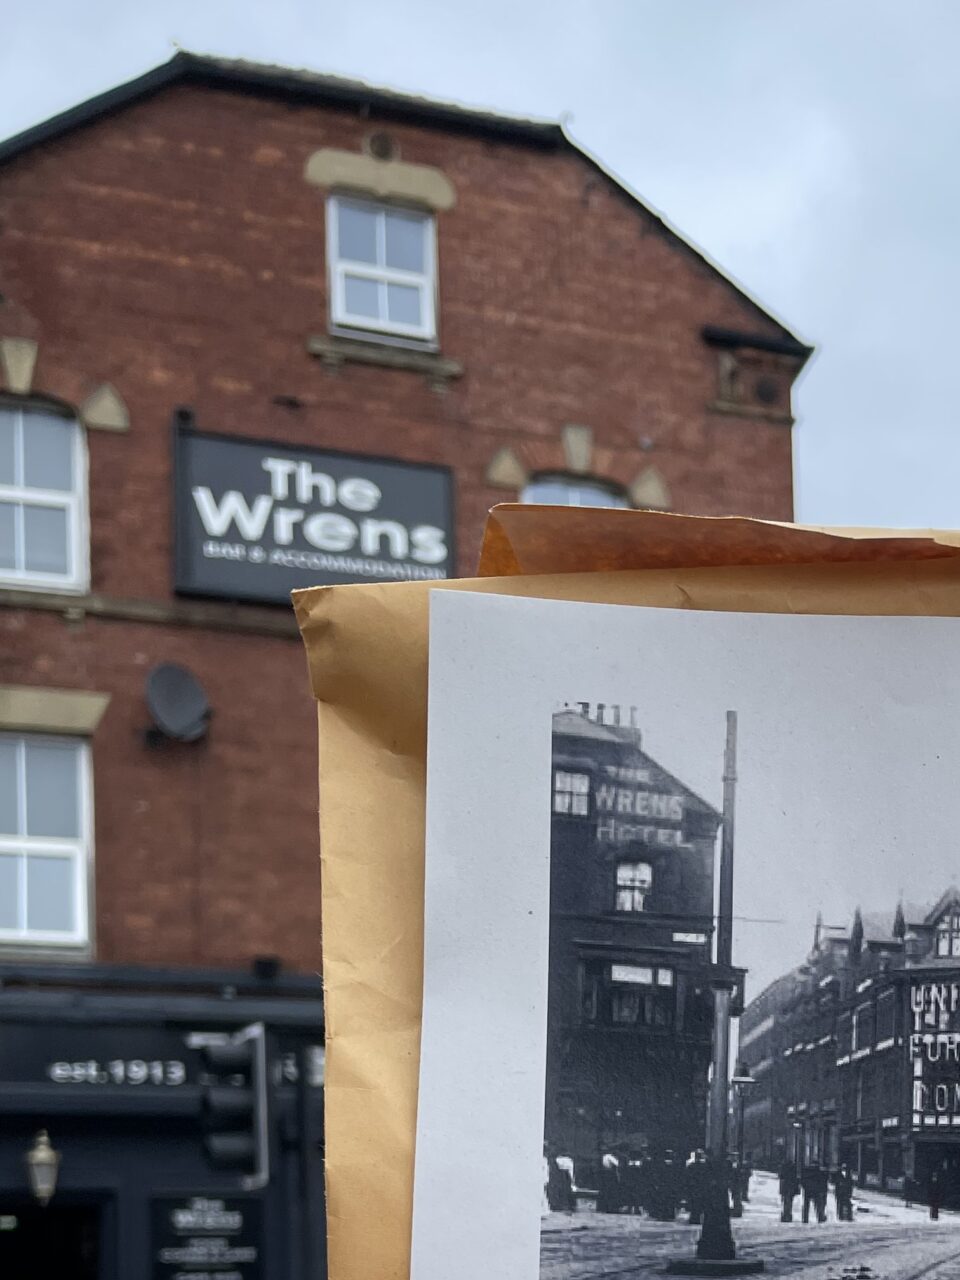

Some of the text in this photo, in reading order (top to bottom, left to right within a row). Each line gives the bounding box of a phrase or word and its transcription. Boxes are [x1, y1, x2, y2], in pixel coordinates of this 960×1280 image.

[261, 456, 382, 512] The
[191, 485, 448, 565] Wrens
[596, 783, 684, 820] WRENS
[111, 1058, 187, 1086] 1913
